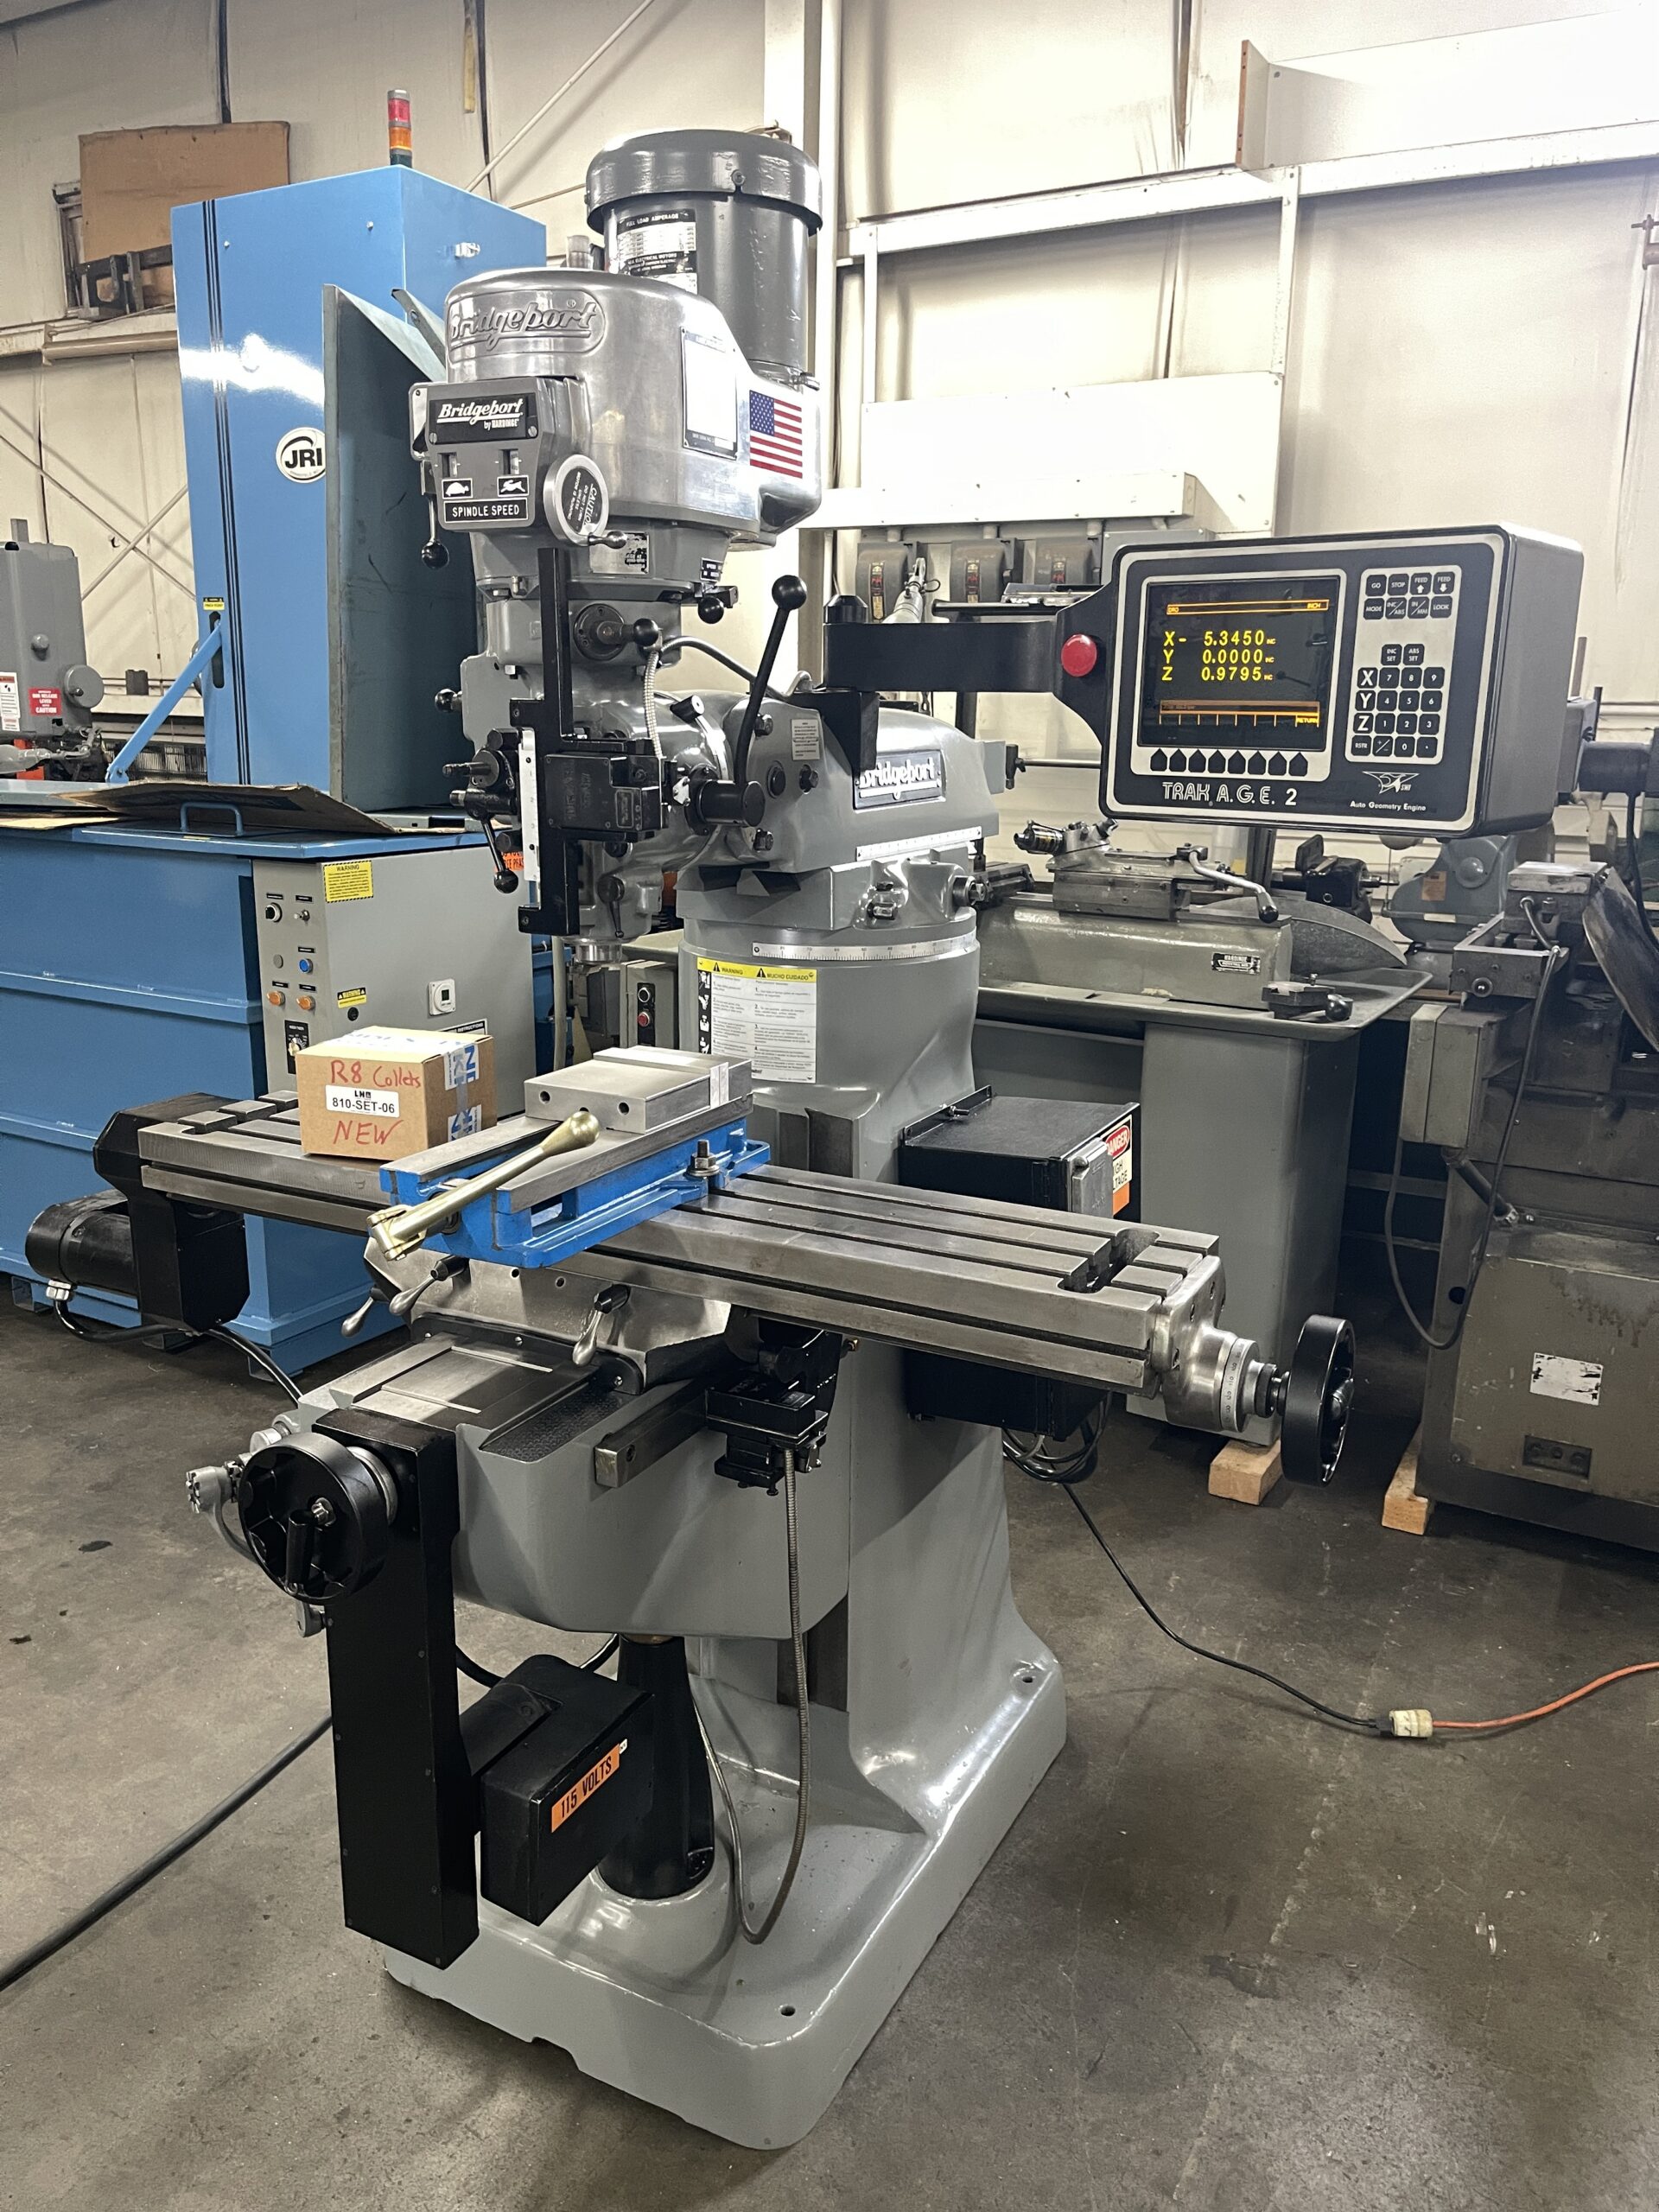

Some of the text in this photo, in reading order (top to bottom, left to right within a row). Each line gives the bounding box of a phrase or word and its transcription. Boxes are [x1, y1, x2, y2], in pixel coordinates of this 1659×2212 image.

[652, 213, 679, 221] AMPERAGE
[450, 302, 597, 352] Bridgeport
[437, 398, 524, 425] Bridgeport
[484, 420, 491, 430] by
[284, 448, 323, 468] JRI
[452, 504, 520, 518] SPINDLE SPEED
[1163, 631, 1175, 646] X
[1204, 629, 1265, 646] 5.3450
[1163, 649, 1174, 664] Y
[1202, 649, 1263, 664] 0.0000
[1161, 666, 1173, 681] Z
[1201, 666, 1262, 681] 0.9795
[1360, 670, 1374, 686] X
[1360, 693, 1372, 709] Y
[1357, 715, 1370, 732] Z
[859, 756, 935, 800] Bridgeport
[1162, 781, 1210, 802] TRAK
[1284, 788, 1298, 806] 2
[1369, 802, 1402, 811] Geometry
[1403, 804, 1426, 812] Engine
[330, 1059, 362, 1084] R8
[373, 1065, 422, 1089] Collets
[332, 1097, 395, 1114] 810-SET-06
[333, 1119, 404, 1145] NEW
[561, 1755, 612, 1818] 115 VOLTS
